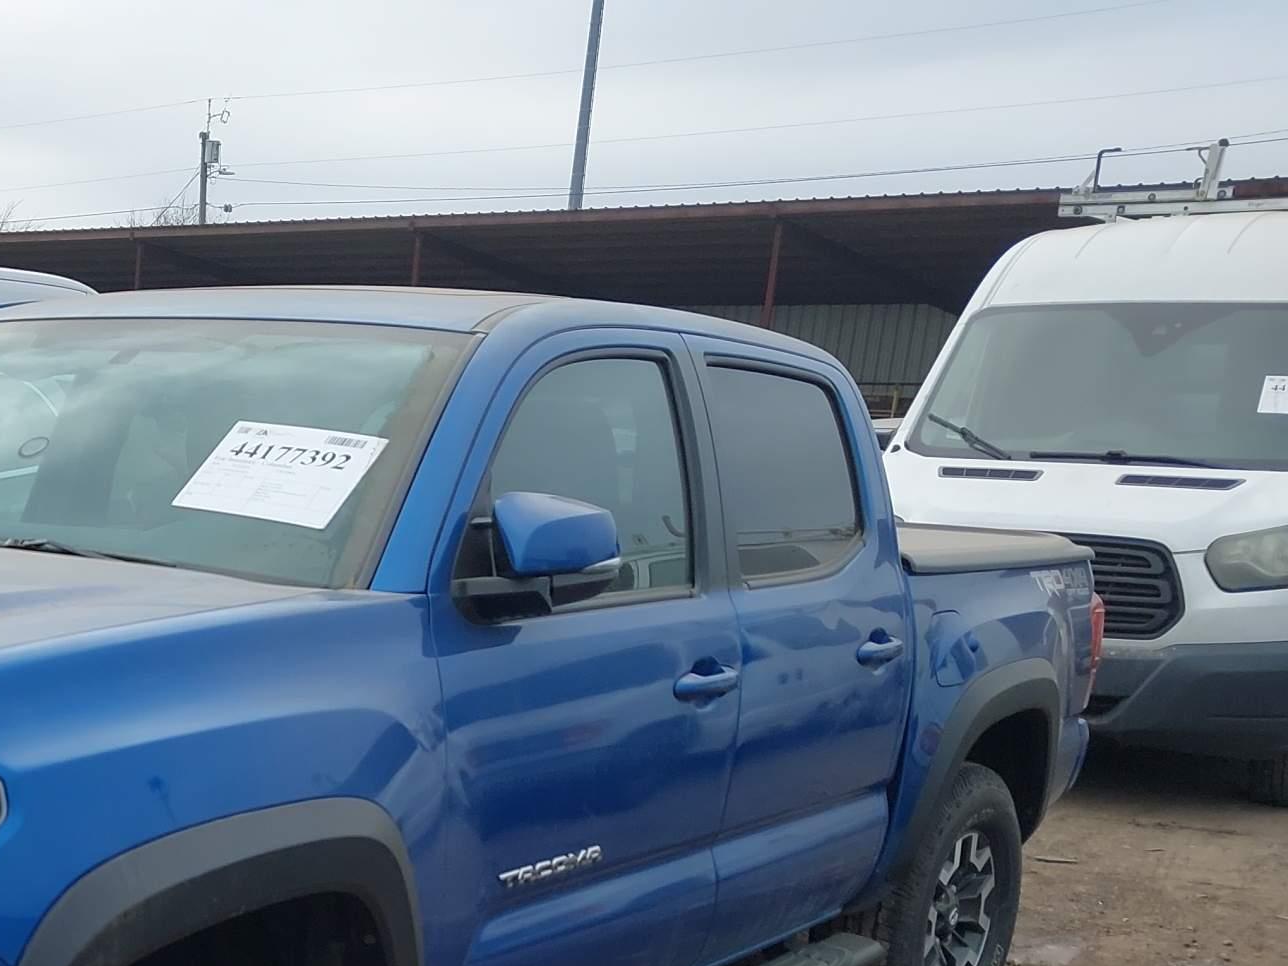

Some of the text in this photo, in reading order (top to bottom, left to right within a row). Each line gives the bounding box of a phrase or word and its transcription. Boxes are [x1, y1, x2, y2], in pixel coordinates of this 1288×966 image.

[230, 441, 352, 471] 44177392
[1030, 569, 1065, 599] TRD
[498, 845, 602, 888] TACOMA
